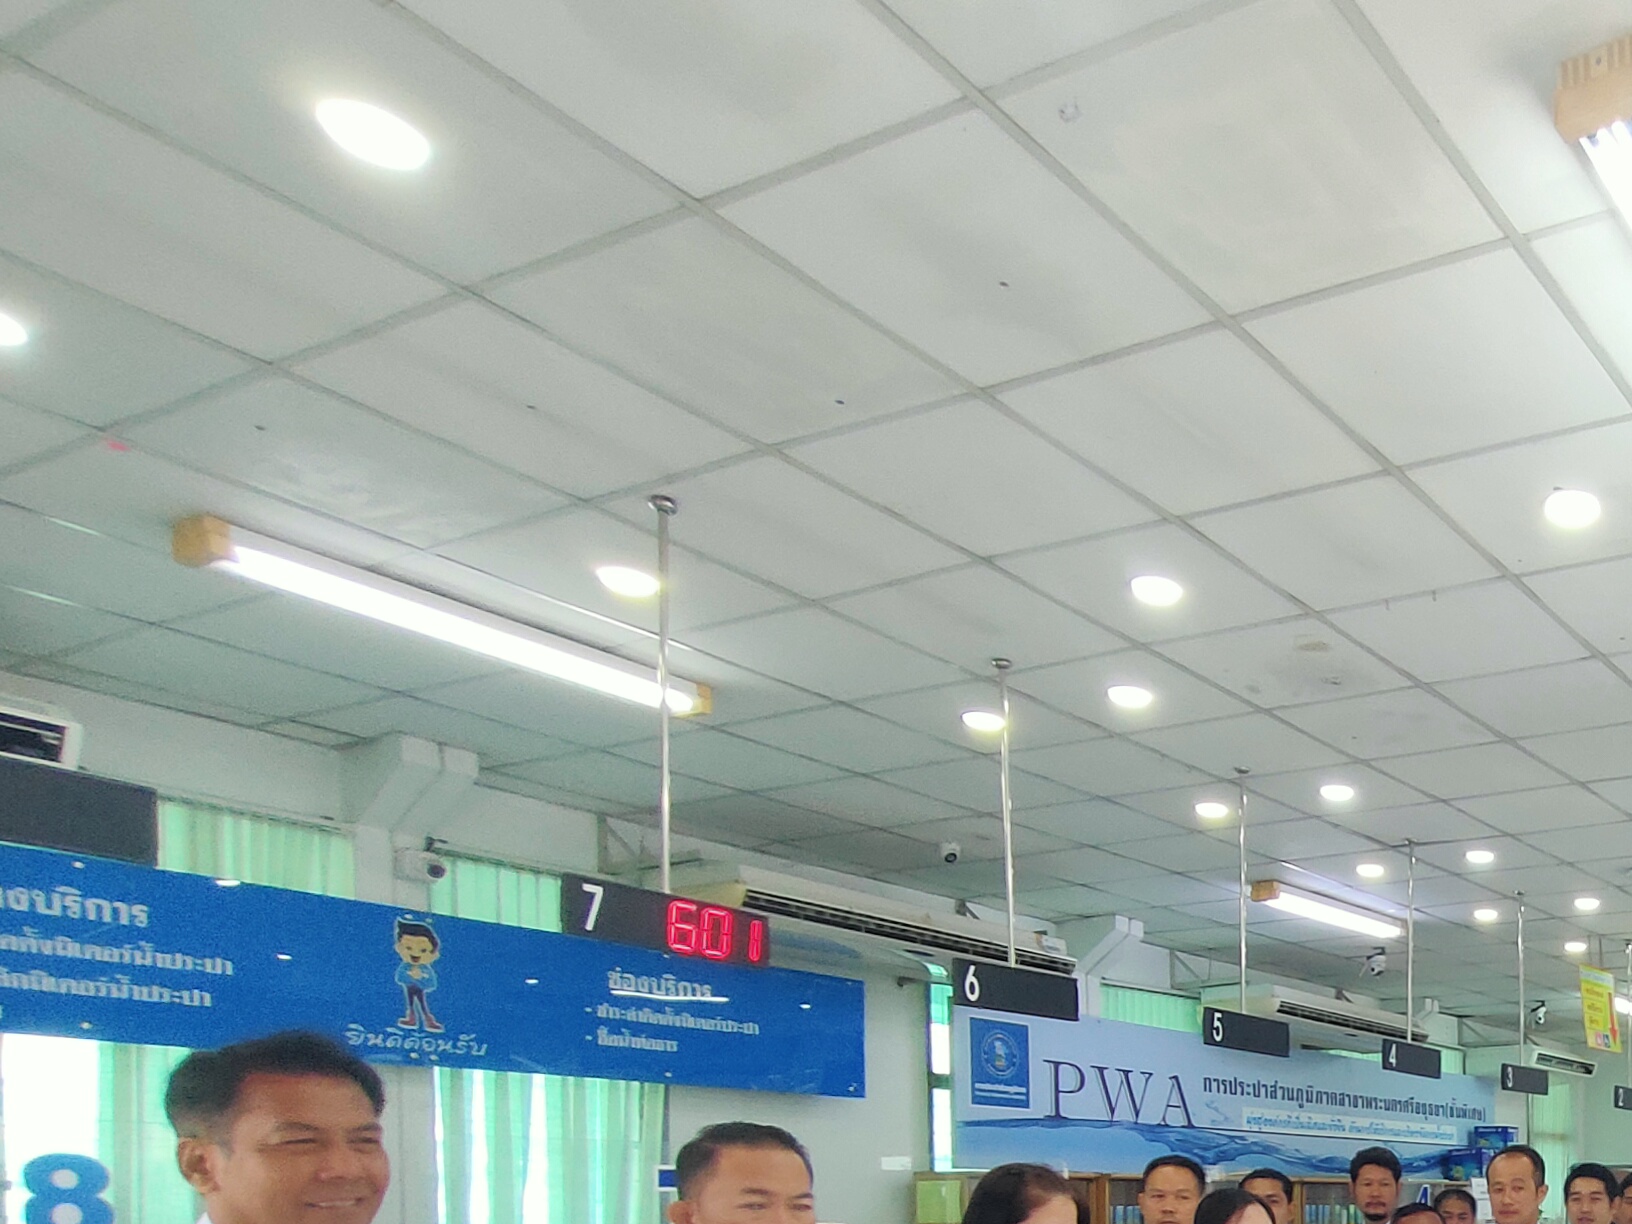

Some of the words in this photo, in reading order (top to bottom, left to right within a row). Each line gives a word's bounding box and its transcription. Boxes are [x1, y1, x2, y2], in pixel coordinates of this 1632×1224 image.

[582, 883, 604, 931] 7
[667, 900, 763, 962] 601
[608, 967, 713, 998] ช่องบริการ
[964, 964, 980, 1002] 6
[1212, 1012, 1223, 1042] 5
[1389, 1043, 1397, 1067] 4
[1042, 1059, 1196, 1128] PWA
[1507, 1066, 1513, 1088] 3
